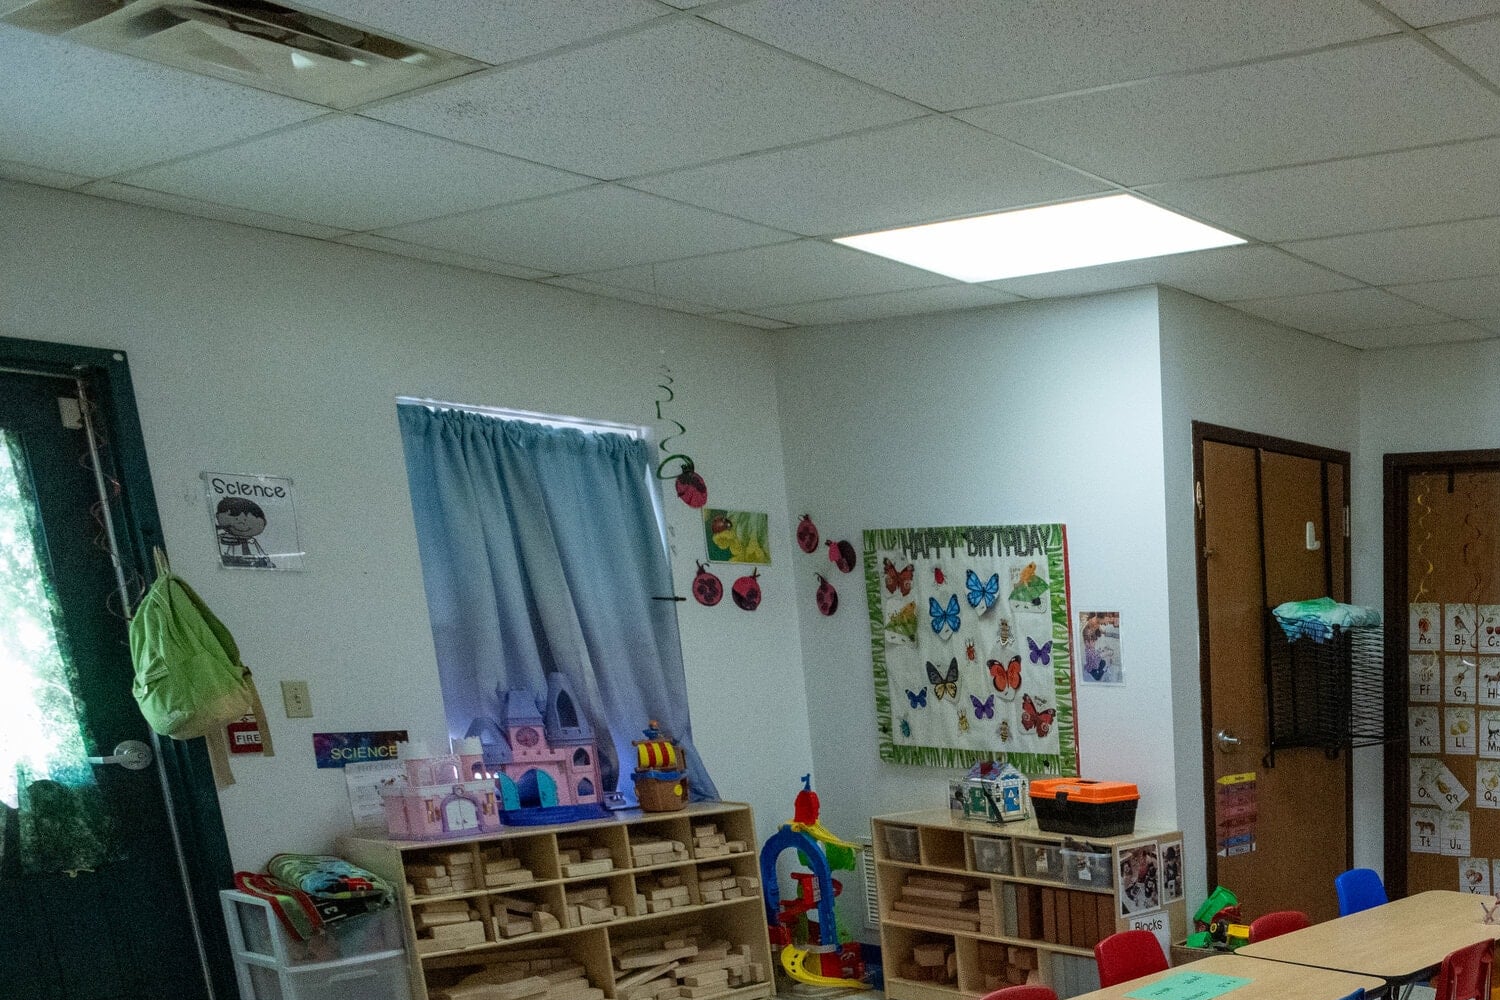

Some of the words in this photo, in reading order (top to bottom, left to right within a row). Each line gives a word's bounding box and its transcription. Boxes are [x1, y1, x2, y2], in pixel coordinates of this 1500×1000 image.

[211, 477, 286, 498] Science
[901, 527, 956, 560] HAPPY
[966, 524, 1050, 558] BIRTHDAY
[1454, 634, 1466, 645] Bb
[1487, 636, 1500, 647] Cc
[1454, 686, 1467, 697] Gg
[236, 733, 260, 743] FIRE
[1419, 736, 1431, 746] Kk
[1455, 737, 1466, 748] Ll
[330, 745, 398, 760] SCIENCE
[1484, 791, 1497, 806] Qq
[1419, 836, 1431, 847] Tt
[1450, 838, 1461, 850] Uu
[1135, 919, 1163, 931] Blocks
